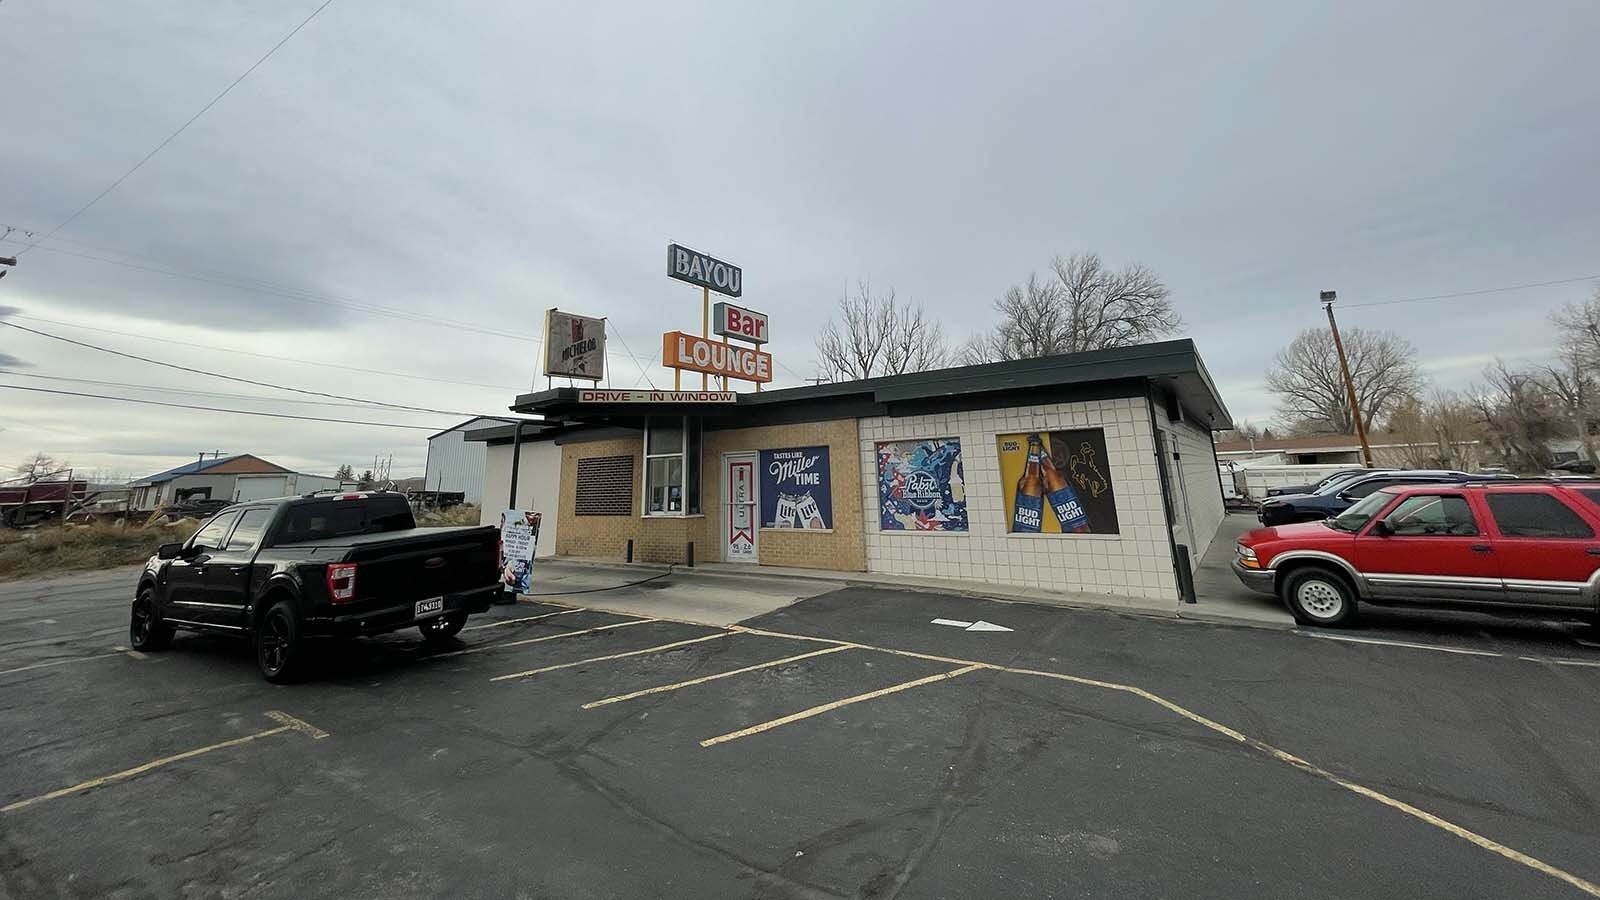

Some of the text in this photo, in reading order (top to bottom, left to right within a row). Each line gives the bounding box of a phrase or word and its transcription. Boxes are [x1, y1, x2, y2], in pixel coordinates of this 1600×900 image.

[676, 248, 740, 293] BAYOU
[727, 307, 765, 338] Bar
[678, 336, 769, 378] LOUNGE
[582, 392, 630, 401] DRIVE
[650, 392, 664, 401] IN
[670, 392, 732, 401] WINDOW
[769, 456, 820, 485] Miller
[795, 472, 820, 485] TIME
[905, 475, 937, 493] Pabst
[1018, 507, 1039, 518] BUD
[1056, 500, 1077, 514] BUD
[1057, 507, 1084, 522] LIGHT
[1015, 513, 1040, 527] LIGHT
